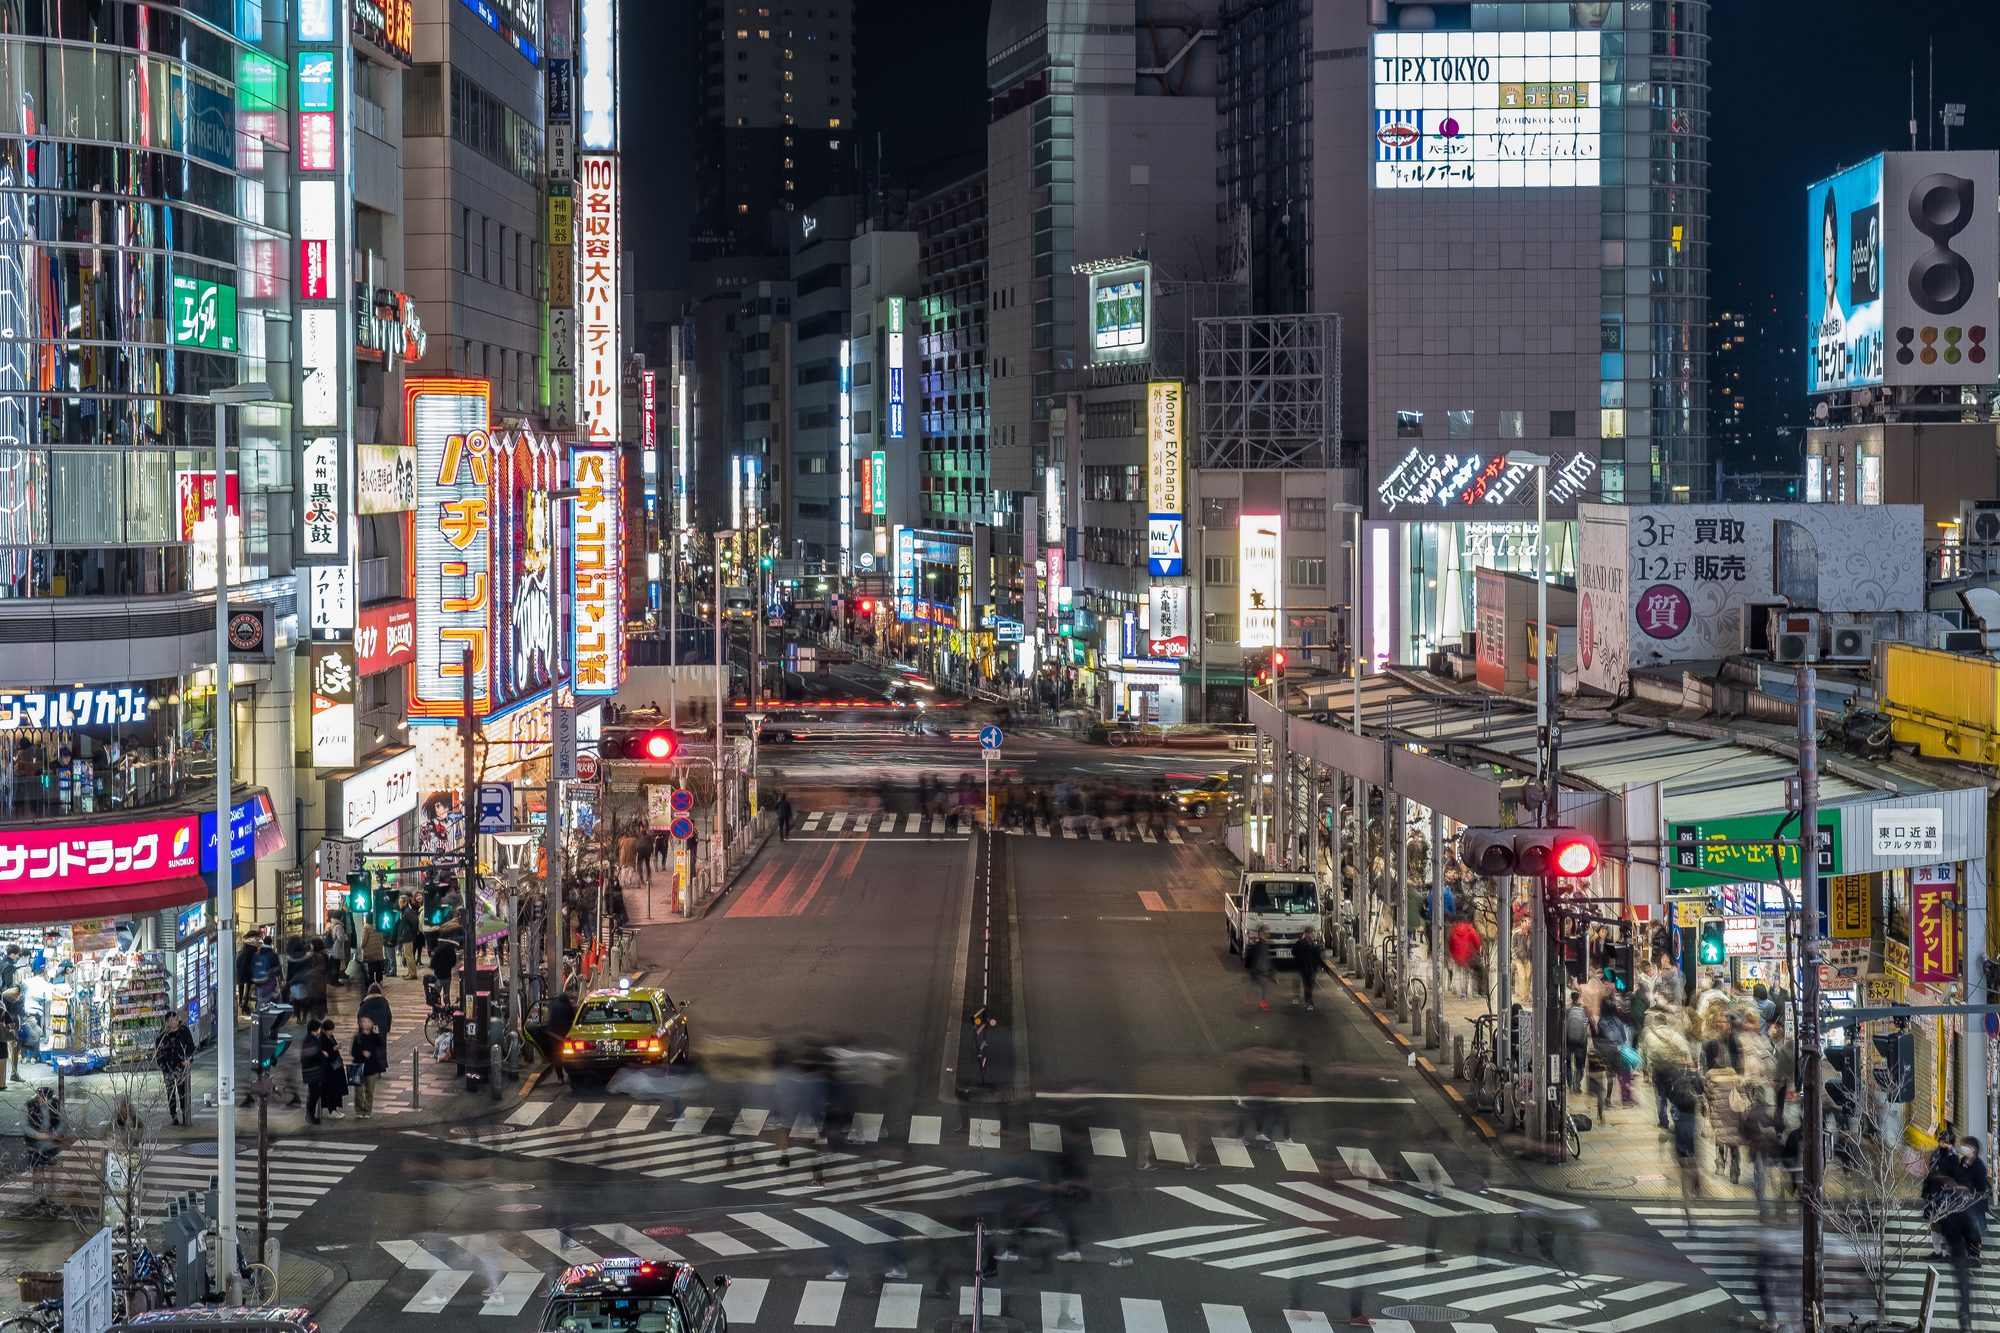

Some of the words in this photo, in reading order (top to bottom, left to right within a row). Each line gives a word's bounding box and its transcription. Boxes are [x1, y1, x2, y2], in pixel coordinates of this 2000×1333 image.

[1383, 57, 1426, 82] TIP.X
[1431, 57, 1490, 82] TOKYO
[190, 116, 233, 159] KIREIMO
[1429, 144, 1468, 155] バーミヤン
[551, 185, 569, 194] 4F
[554, 200, 567, 242] 補聴器
[583, 160, 612, 437] 100名収容大パーティールーム
[1165, 390, 1177, 435] Money
[1381, 453, 1436, 513] Kaleido
[1461, 455, 1506, 505] ジョナサン
[310, 454, 332, 544] 九州黒太鼓
[1461, 534, 1550, 557] Kaleid
[1465, 525, 1512, 534] PACHINKO
[1523, 525, 1540, 534] SLO
[1637, 515, 1675, 547] 3F
[1694, 518, 1746, 545] 買取
[436, 429, 490, 677] パチンコ
[1694, 554, 1747, 582] 販売
[317, 565, 330, 625] ノアール
[1582, 563, 1607, 592] BRAND
[1608, 566, 1624, 594] OFF
[1160, 589, 1172, 637] 丸亀製麺
[1647, 592, 1681, 630] 質
[560, 709, 570, 776] スクランブル交差点
[386, 769, 412, 804] カラオケ
[1878, 827, 1937, 839] 東口近道
[0, 833, 158, 880] サンドラッグ
[168, 857, 194, 868] SUNDRUG
[1919, 864, 1932, 881] 売
[1938, 863, 1951, 880] 取
[1725, 945, 1757, 954] XCHANGE
[1761, 935, 1775, 952] 5
[1919, 892, 1940, 974] チケット
